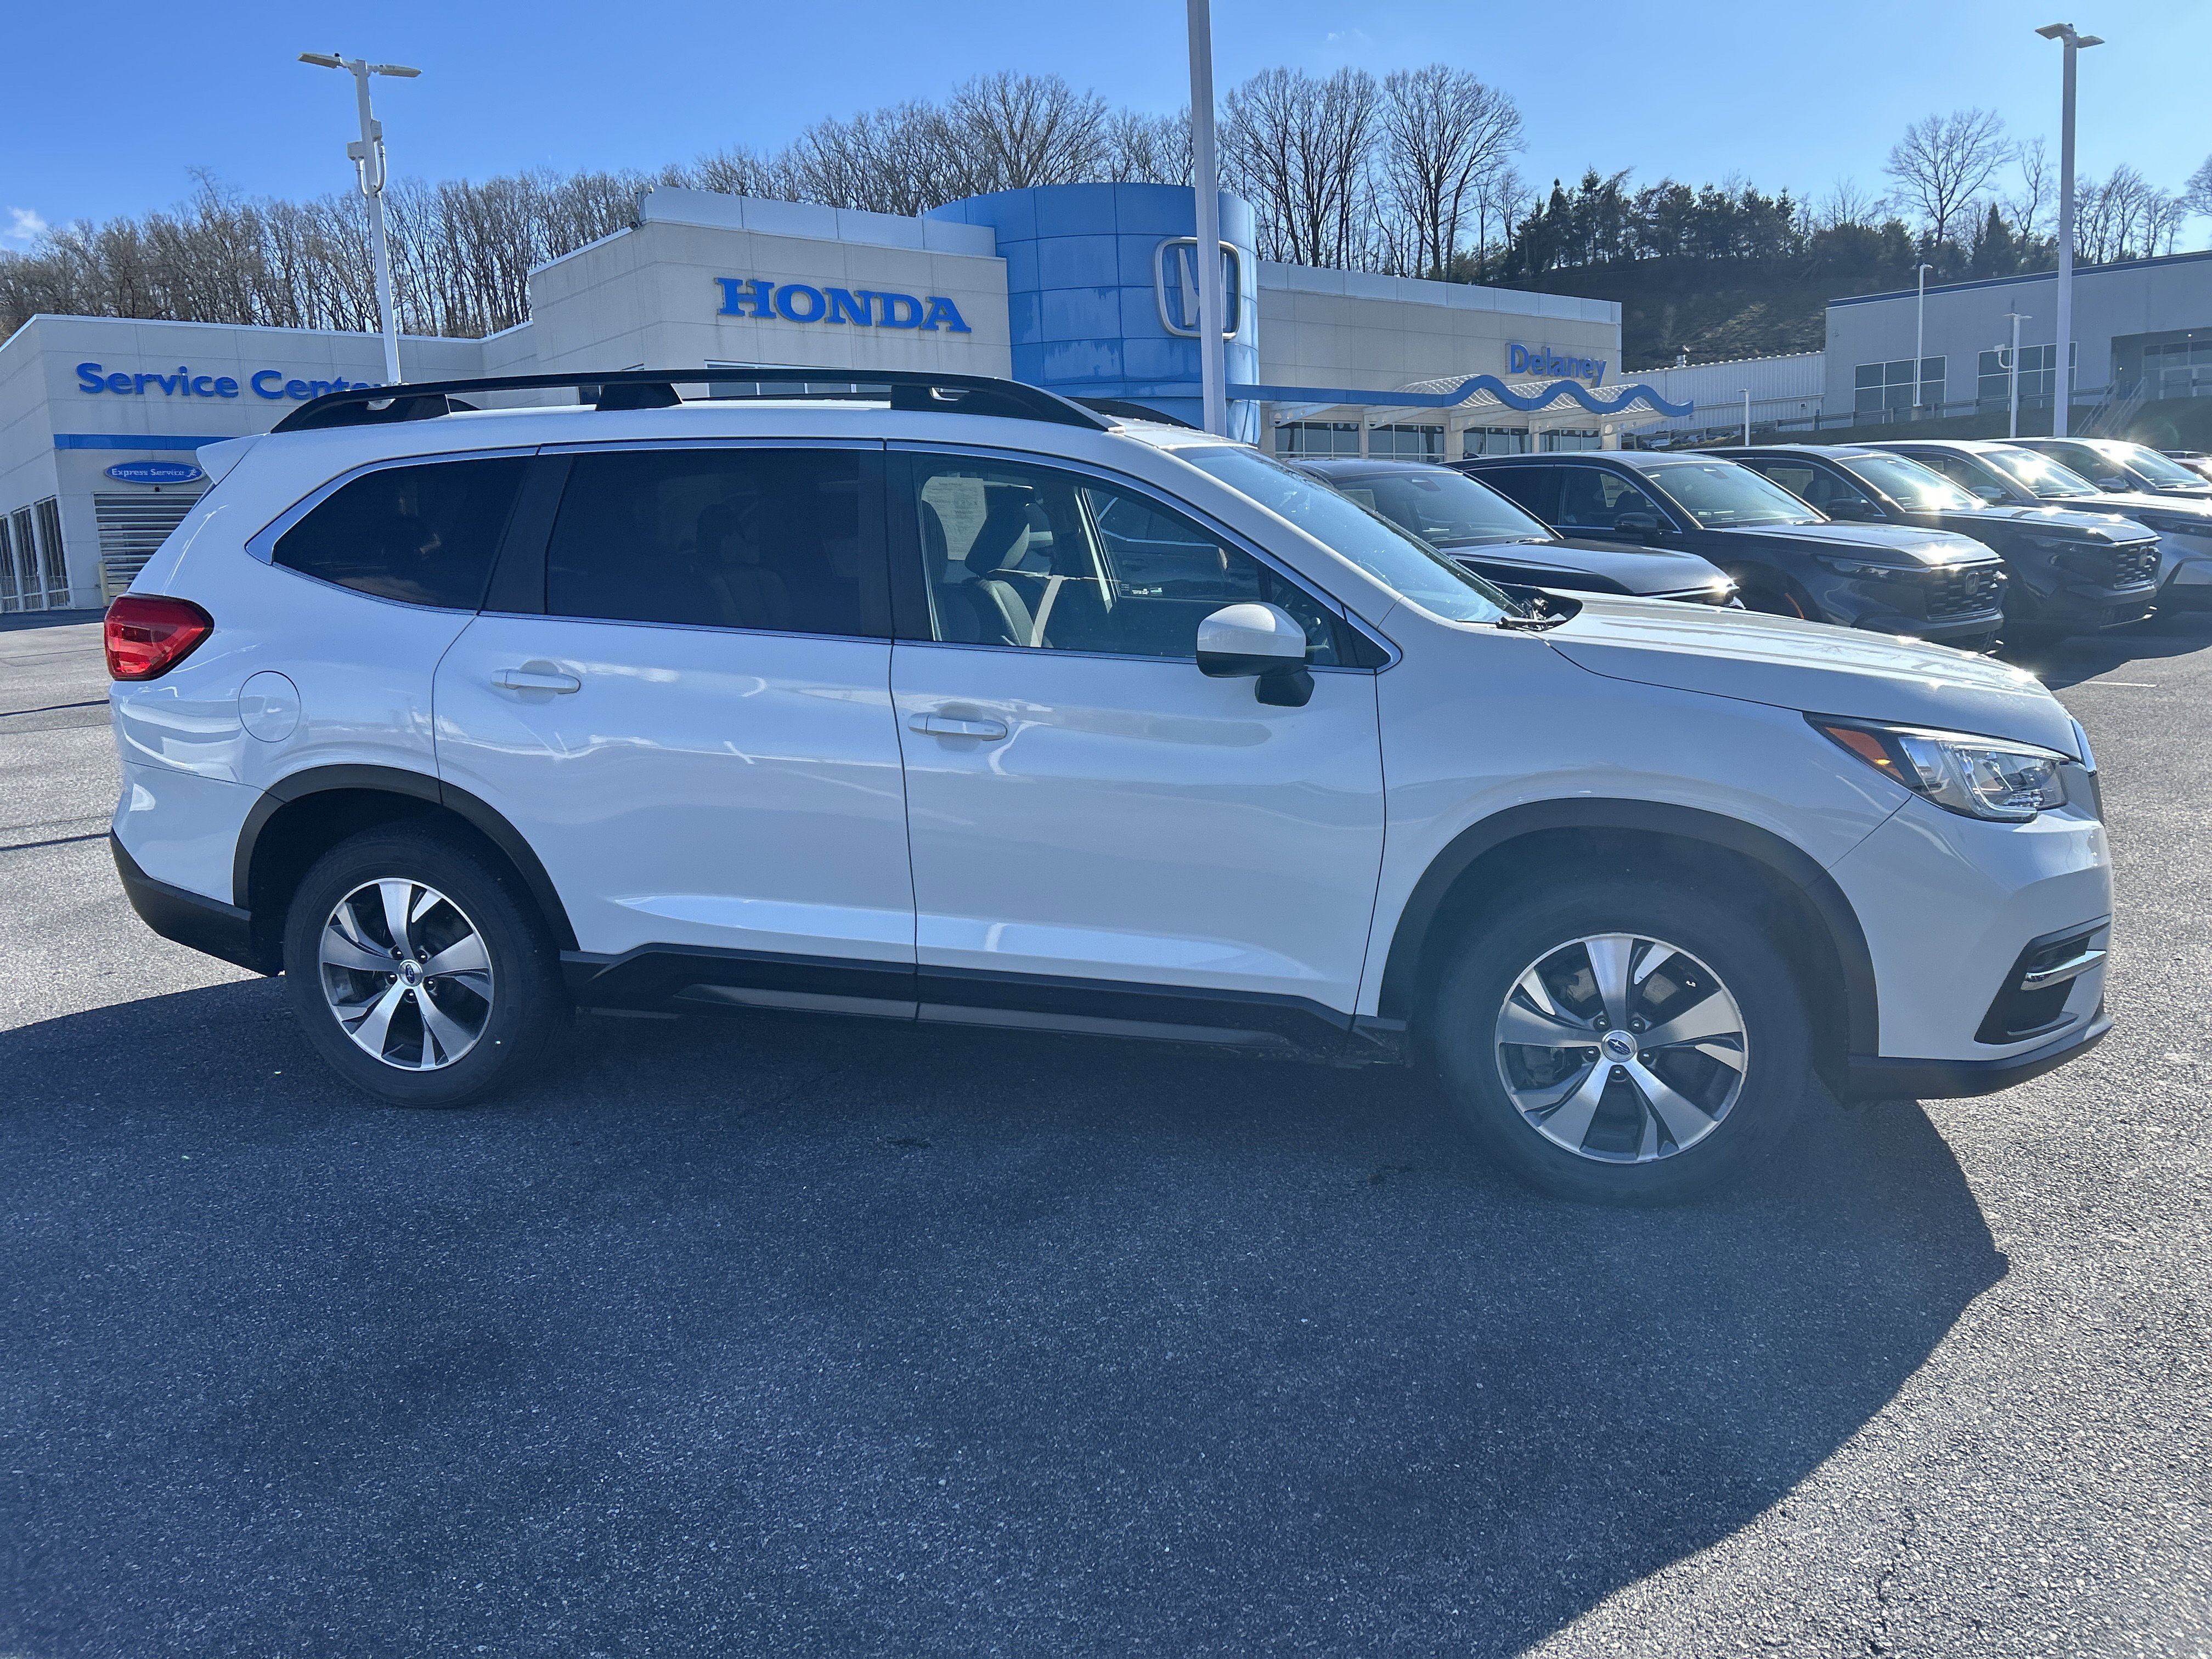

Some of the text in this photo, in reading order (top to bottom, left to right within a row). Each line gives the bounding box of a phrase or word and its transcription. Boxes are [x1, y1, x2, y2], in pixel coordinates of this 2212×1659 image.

[715, 277, 972, 334] HONDA
[76, 362, 383, 399] Service Cent
[1509, 343, 1607, 387] Delaney
[111, 468, 185, 477] Express Service
